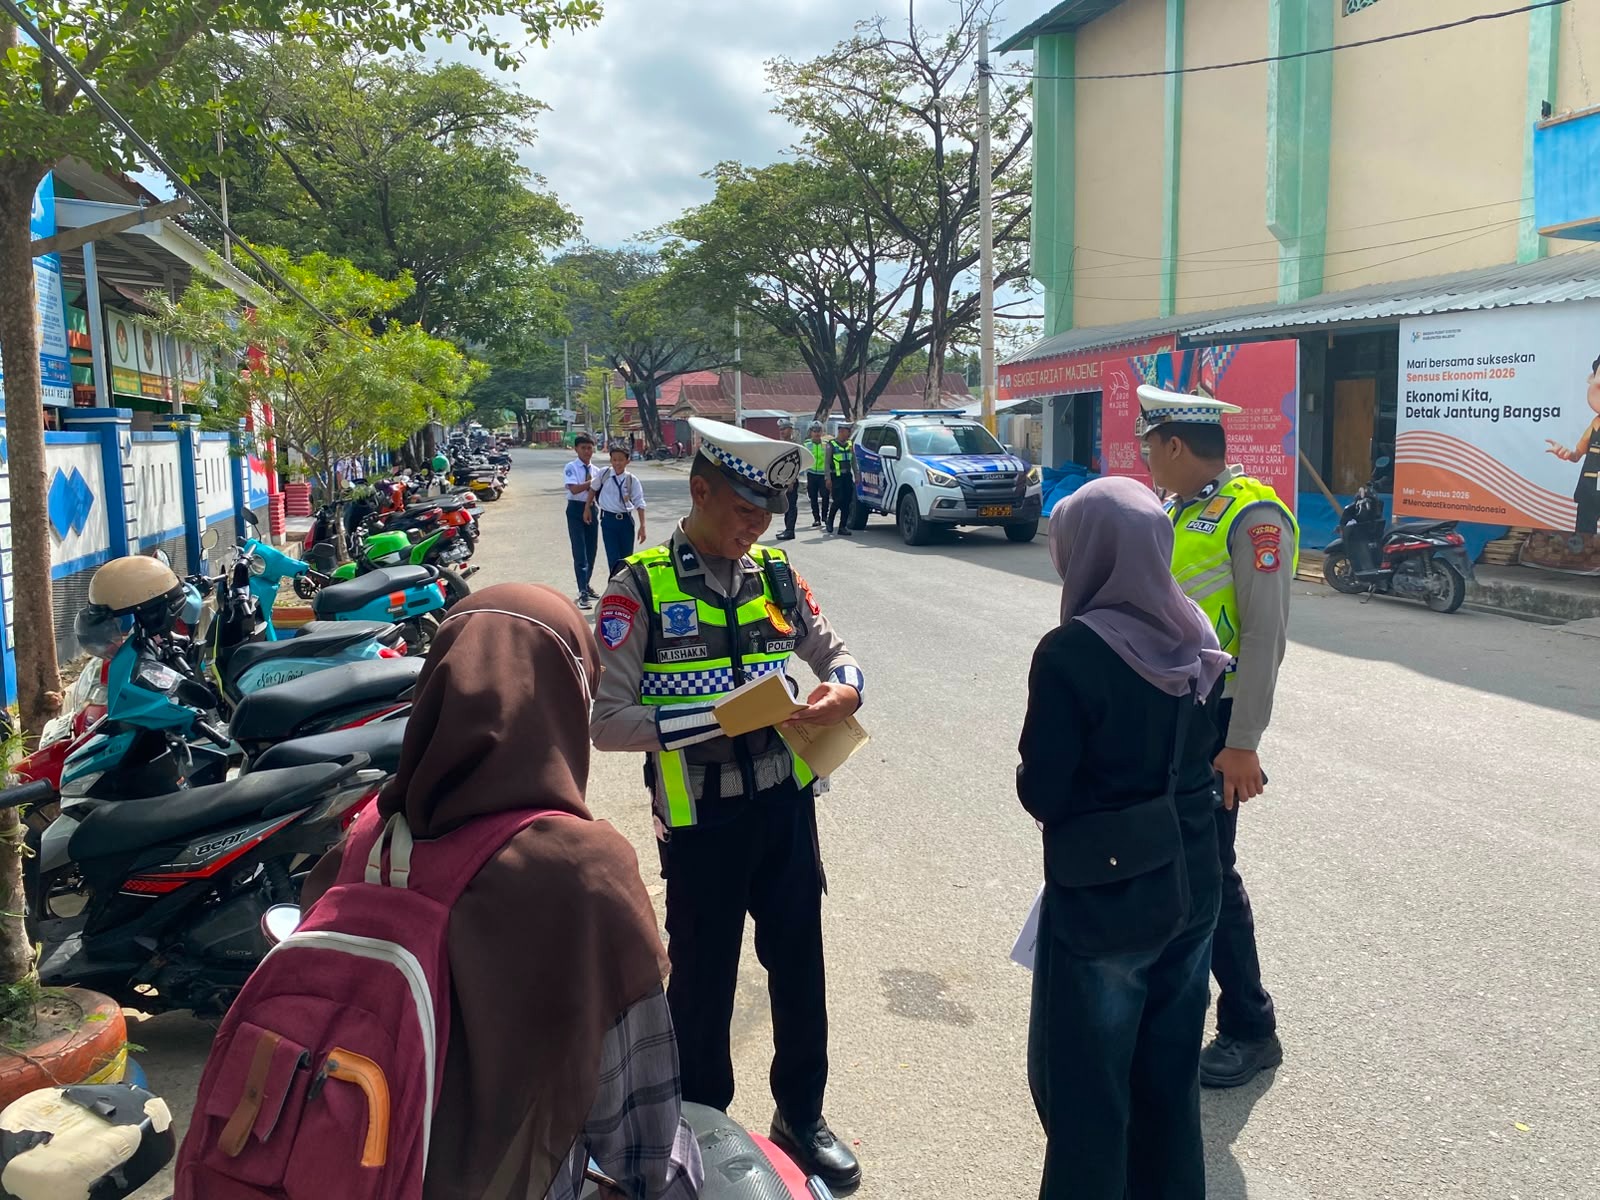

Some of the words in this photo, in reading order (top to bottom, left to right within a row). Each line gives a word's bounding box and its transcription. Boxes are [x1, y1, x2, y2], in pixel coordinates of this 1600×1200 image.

[1406, 358, 1427, 369] Mari
[1429, 357, 1474, 367] bersama
[1476, 352, 1535, 365] sukseskan
[1013, 368, 1064, 387] SEKRETARIAT
[1065, 362, 1098, 381] MAJENE
[1406, 372, 1440, 382] Sensus
[1442, 368, 1487, 381] Ekonomi
[1489, 367, 1515, 378] 2026
[1406, 389, 1459, 403] Ekonomi
[1461, 388, 1493, 403] Kita,
[1405, 406, 1440, 419] Detak
[1443, 405, 1499, 422] Jantung
[1503, 405, 1561, 422] Bangsa
[1227, 434, 1253, 443] RASAKAN
[1227, 444, 1264, 454] PENGALAMAN
[1265, 444, 1281, 454] LARI
[1227, 455, 1242, 463] YANG
[1243, 455, 1259, 464] SERU
[1265, 455, 1285, 464] SARAT
[1246, 465, 1269, 474] BUDAYA
[1270, 465, 1288, 475] LALU
[1402, 487, 1415, 496] Mei
[1421, 489, 1450, 499] Agustus
[1188, 521, 1213, 532] POLRI
[768, 640, 793, 651] POLRI
